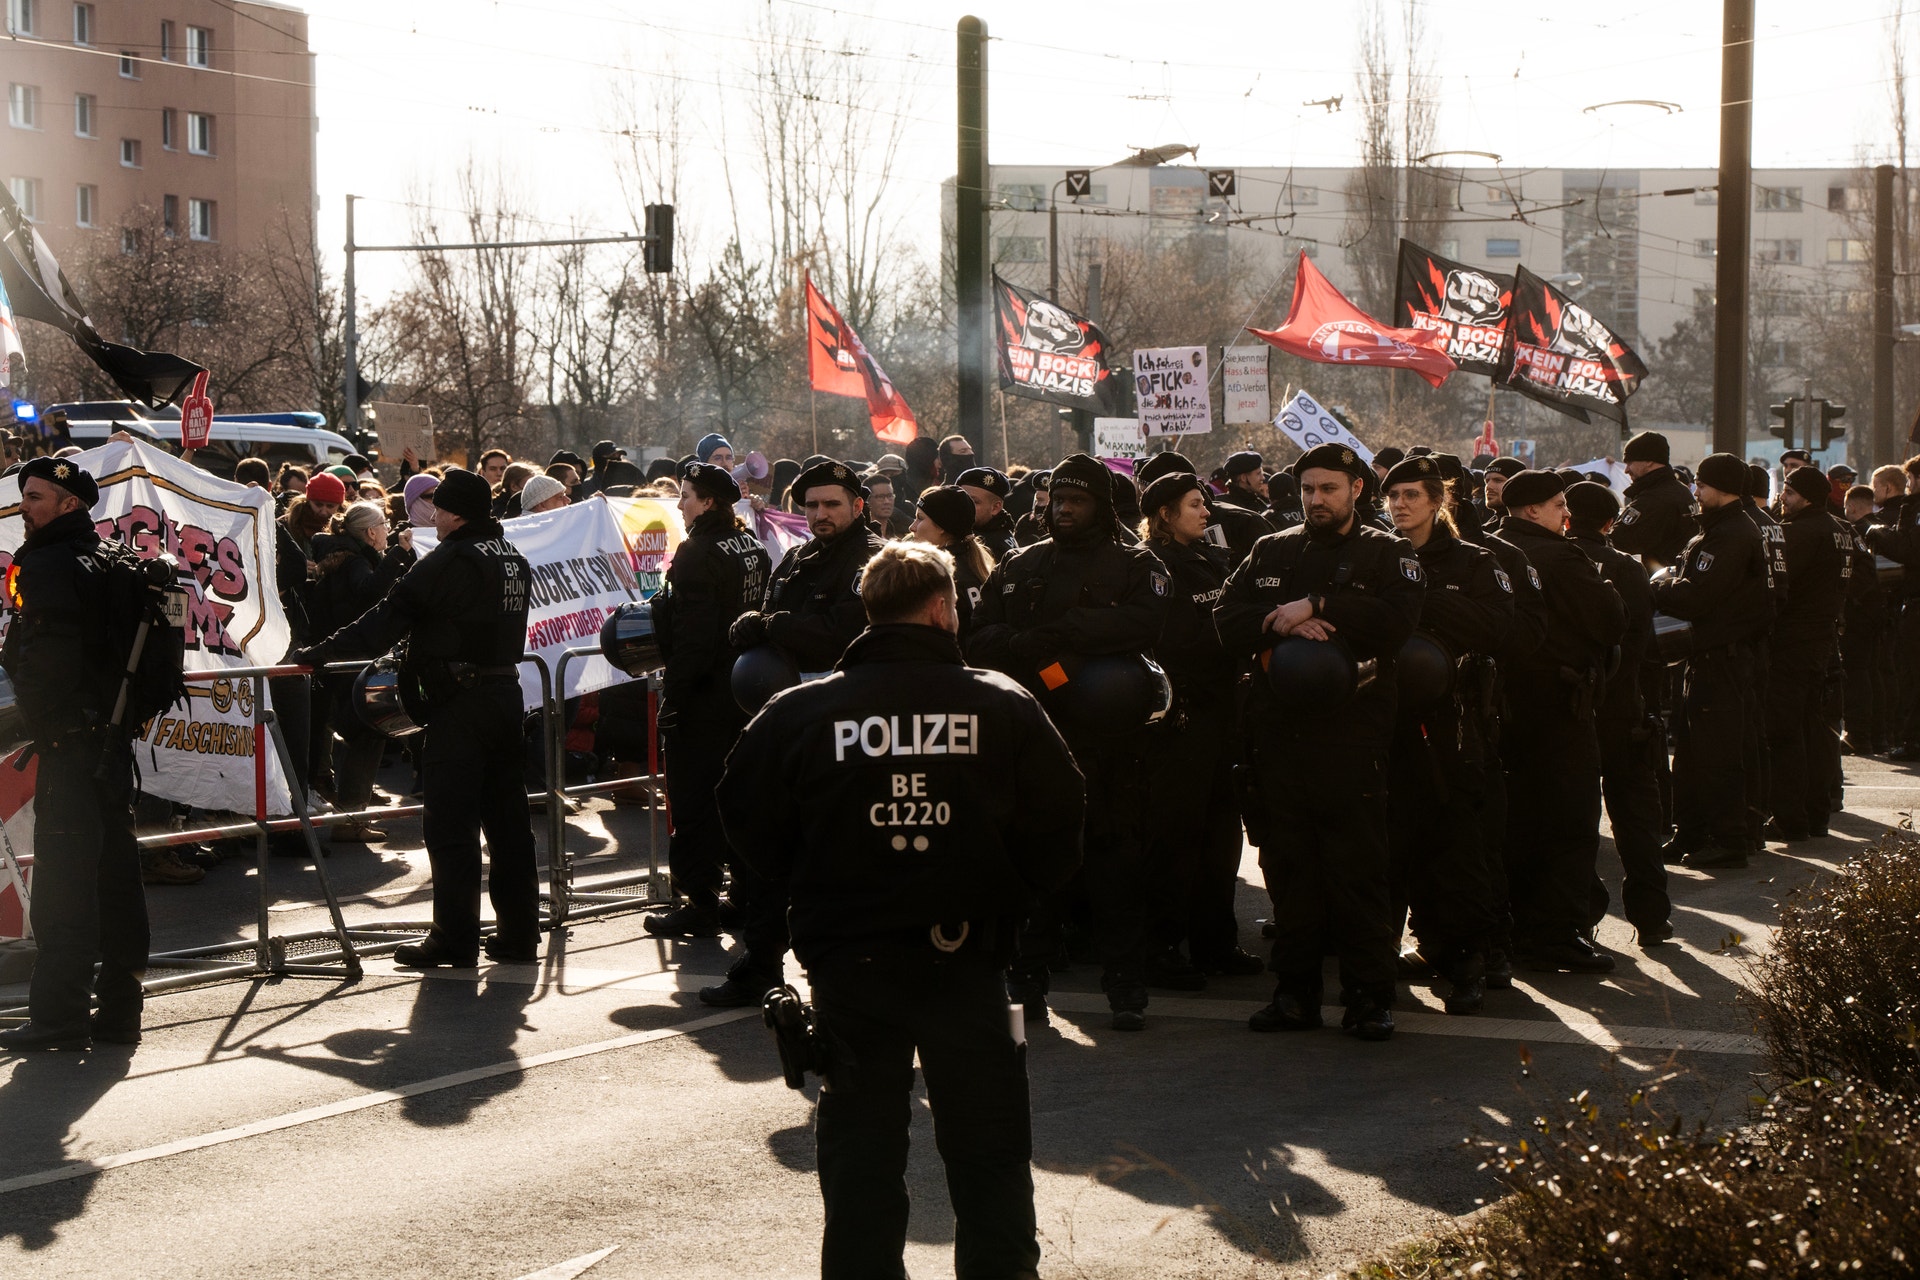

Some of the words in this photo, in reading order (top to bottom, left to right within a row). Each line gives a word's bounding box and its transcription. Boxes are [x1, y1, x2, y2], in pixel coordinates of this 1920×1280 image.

[1008, 346, 1035, 367] EIN
[1039, 355, 1095, 378] BOCK
[1225, 354, 1237, 363] Sie
[1518, 347, 1565, 371] KEIN
[1568, 359, 1606, 380] BOC
[1012, 366, 1030, 378] uf
[1030, 368, 1094, 395] NAZIS
[1225, 367, 1243, 376] Hass
[1243, 366, 1250, 375] &
[1530, 367, 1557, 383] auf
[1150, 370, 1183, 394] FICK
[1227, 382, 1266, 393] AfD-Verbot
[1104, 441, 1145, 453] MAXIMUM
[1055, 477, 1089, 488] POLIZEI
[473, 538, 520, 556] POLIZ
[503, 561, 520, 577] BP
[744, 555, 760, 572] BP
[503, 577, 526, 596] HÜN
[565, 558, 602, 597] IST
[1255, 576, 1281, 588] POLIZEI
[502, 596, 524, 612] 1120
[742, 585, 762, 604] 1121
[527, 607, 605, 651] #STOPPTDIEAFD
[154, 717, 256, 758] FASCHISMU
[834, 713, 979, 762] POLIZEI
[891, 773, 927, 798] BE
[869, 801, 951, 827] C1220
